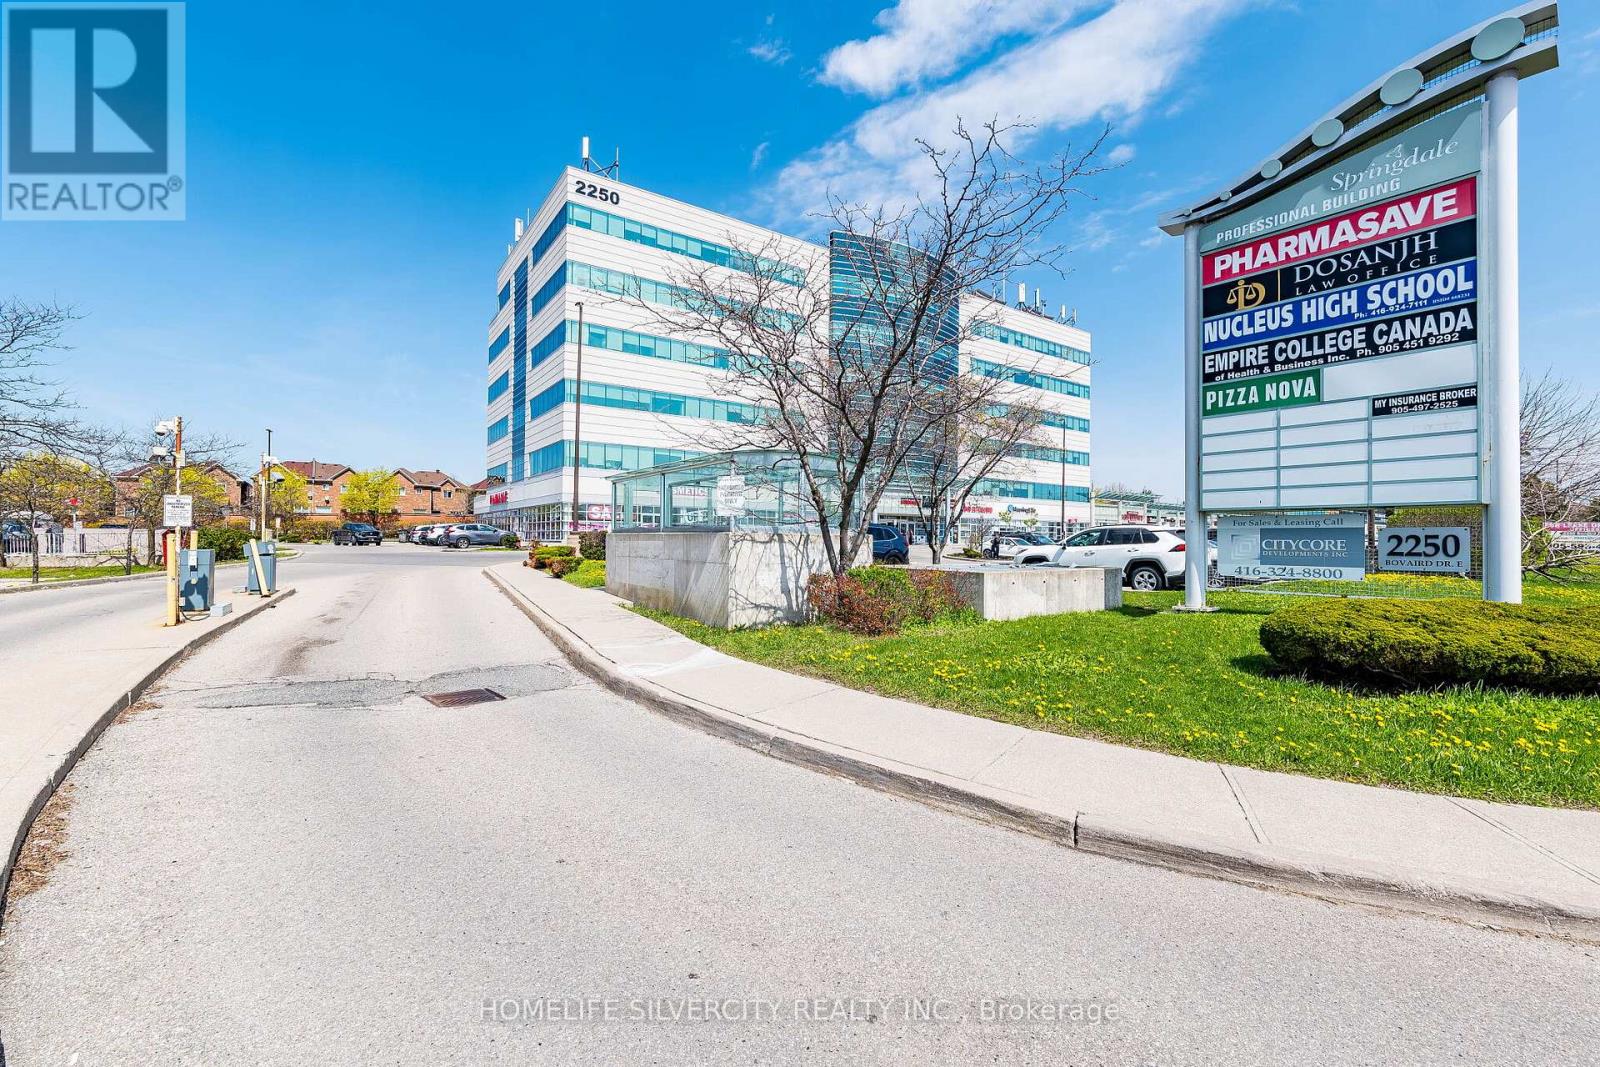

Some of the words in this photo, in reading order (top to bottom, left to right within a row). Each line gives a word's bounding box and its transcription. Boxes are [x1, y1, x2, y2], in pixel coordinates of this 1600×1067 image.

[1330, 140, 1458, 193] Springdale
[575, 180, 620, 205] 2250
[1216, 204, 1318, 244] PROFESSIONAL
[1322, 178, 1401, 212] BUILDING
[1214, 188, 1458, 278] PHARMASAVE
[1294, 231, 1439, 283] DOSANJH
[1296, 279, 1336, 296] LAW
[1347, 254, 1438, 283] OFFICE
[1204, 303, 1294, 344] NUCLEUS
[1302, 289, 1358, 324] HIGH
[1366, 265, 1474, 310] SCHOOL
[1371, 299, 1428, 316] 416-924-7111
[1204, 344, 1269, 374] EMPIRE
[1274, 326, 1366, 362] COLLEGE
[1373, 307, 1474, 345] CANADA
[1356, 348, 1375, 357] Ph.
[1378, 344, 1400, 354] 905
[1402, 339, 1424, 350] 451
[1428, 332, 1460, 345] 9292
[1227, 367, 1260, 380] Health
[1263, 365, 1271, 373] &
[1274, 357, 1324, 372] Business
[1327, 353, 1350, 363] Inc.
[1206, 385, 1260, 411] PIZZA
[1265, 376, 1317, 402] NOVA
[1374, 399, 1387, 409] MY
[1388, 392, 1437, 407] INSURANCE
[1439, 388, 1477, 401] BROKER
[1391, 400, 1459, 415] 905-497-2525
[1232, 519, 1246, 527] For
[1249, 518, 1272, 527] Sales
[1274, 518, 1281, 526] &
[1284, 517, 1321, 528] Leasing
[1323, 518, 1344, 526] Call
[1262, 539, 1347, 551] CITYCORE
[1386, 534, 1460, 558] 2250
[1234, 566, 1343, 579] 416-324-8800
